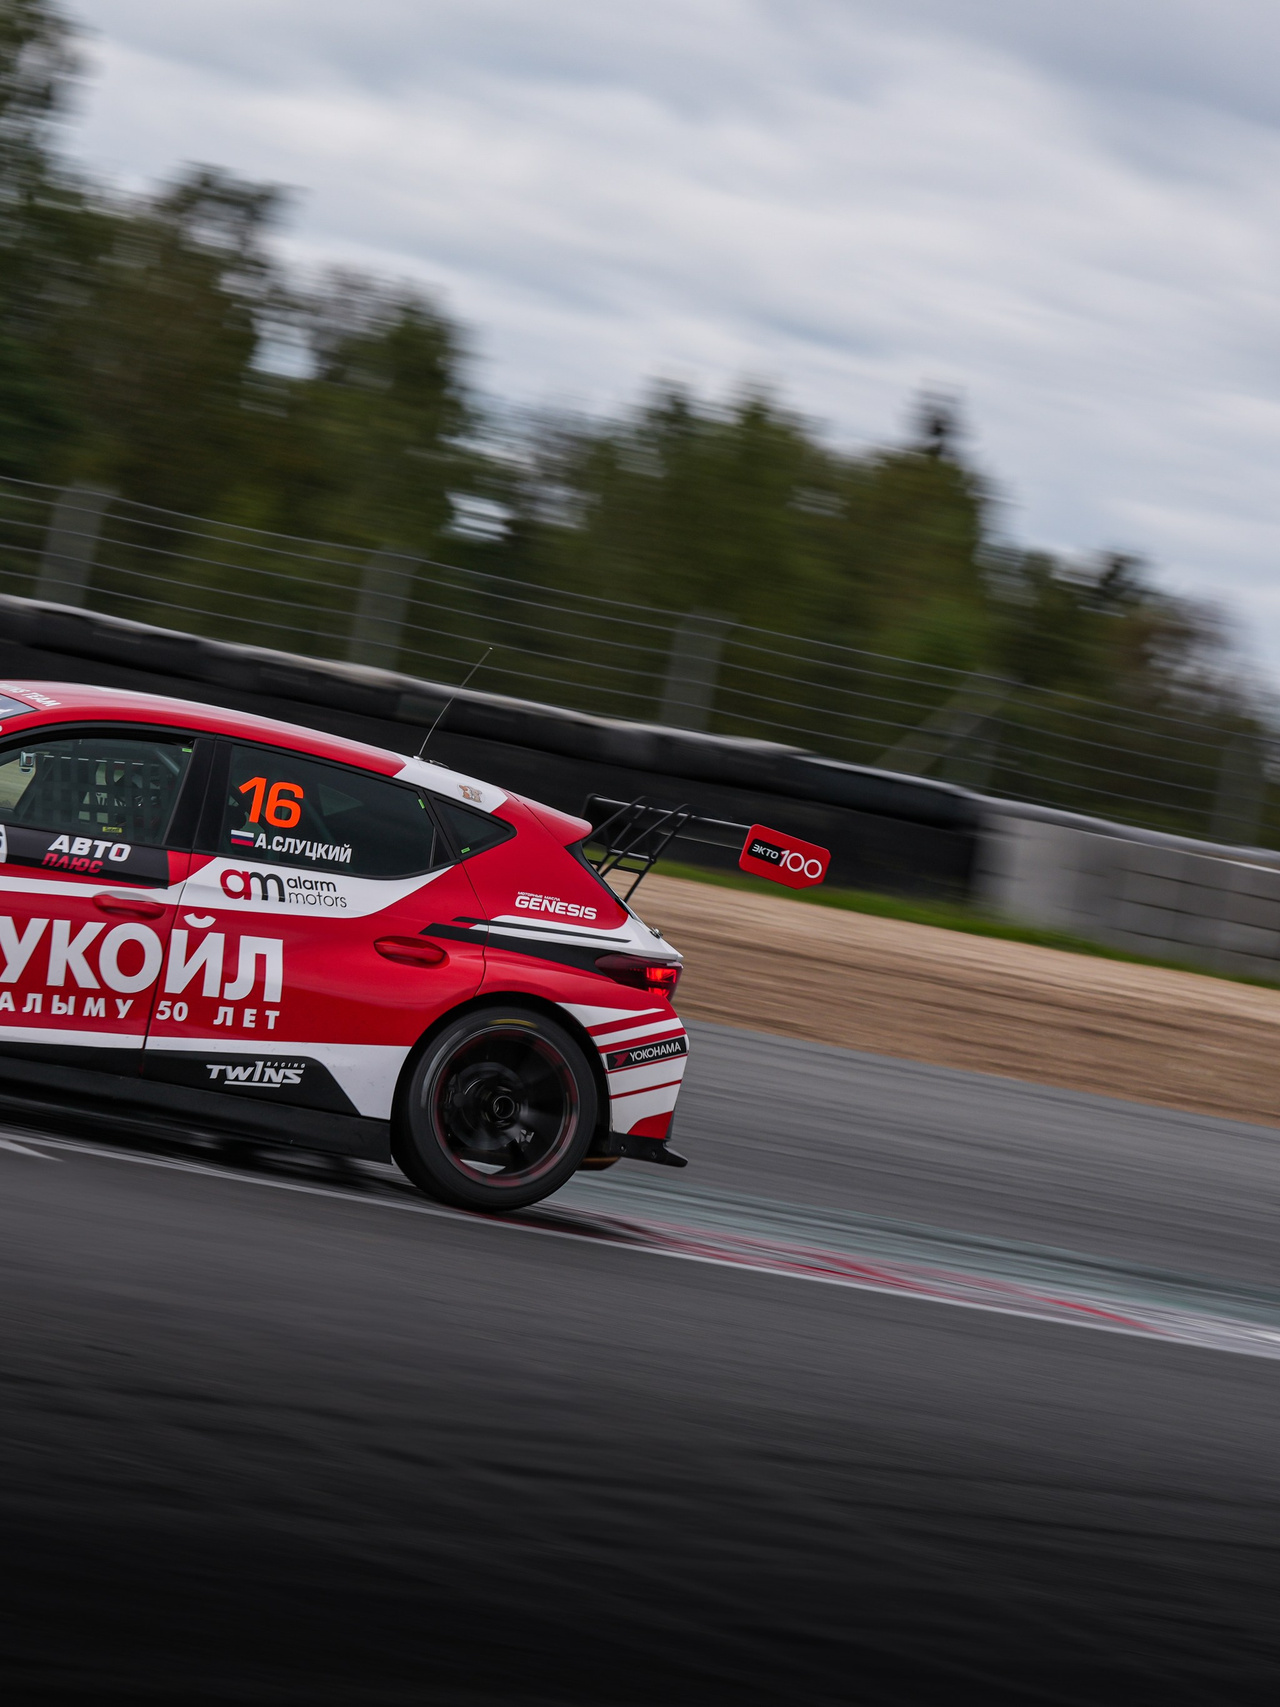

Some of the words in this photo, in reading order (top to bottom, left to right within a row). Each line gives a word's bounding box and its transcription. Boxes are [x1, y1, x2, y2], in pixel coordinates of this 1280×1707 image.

[238, 776, 304, 829] 16
[47, 834, 132, 862] АВТО
[254, 833, 352, 863] А.СЛУЦКИЙ
[42, 852, 104, 873] ПЛЮС
[751, 843, 779, 859] ЭКТО
[779, 850, 823, 879] 100
[220, 868, 285, 902] am
[287, 875, 337, 892] alarm
[288, 891, 347, 908] motors
[515, 895, 597, 920] GENESIS
[155, 1000, 189, 1022] 50
[213, 1006, 280, 1030] ЛЕТ
[629, 1041, 682, 1062] YOKOHAMA
[205, 1060, 304, 1084] TWINS
[266, 1061, 306, 1069] RACING
